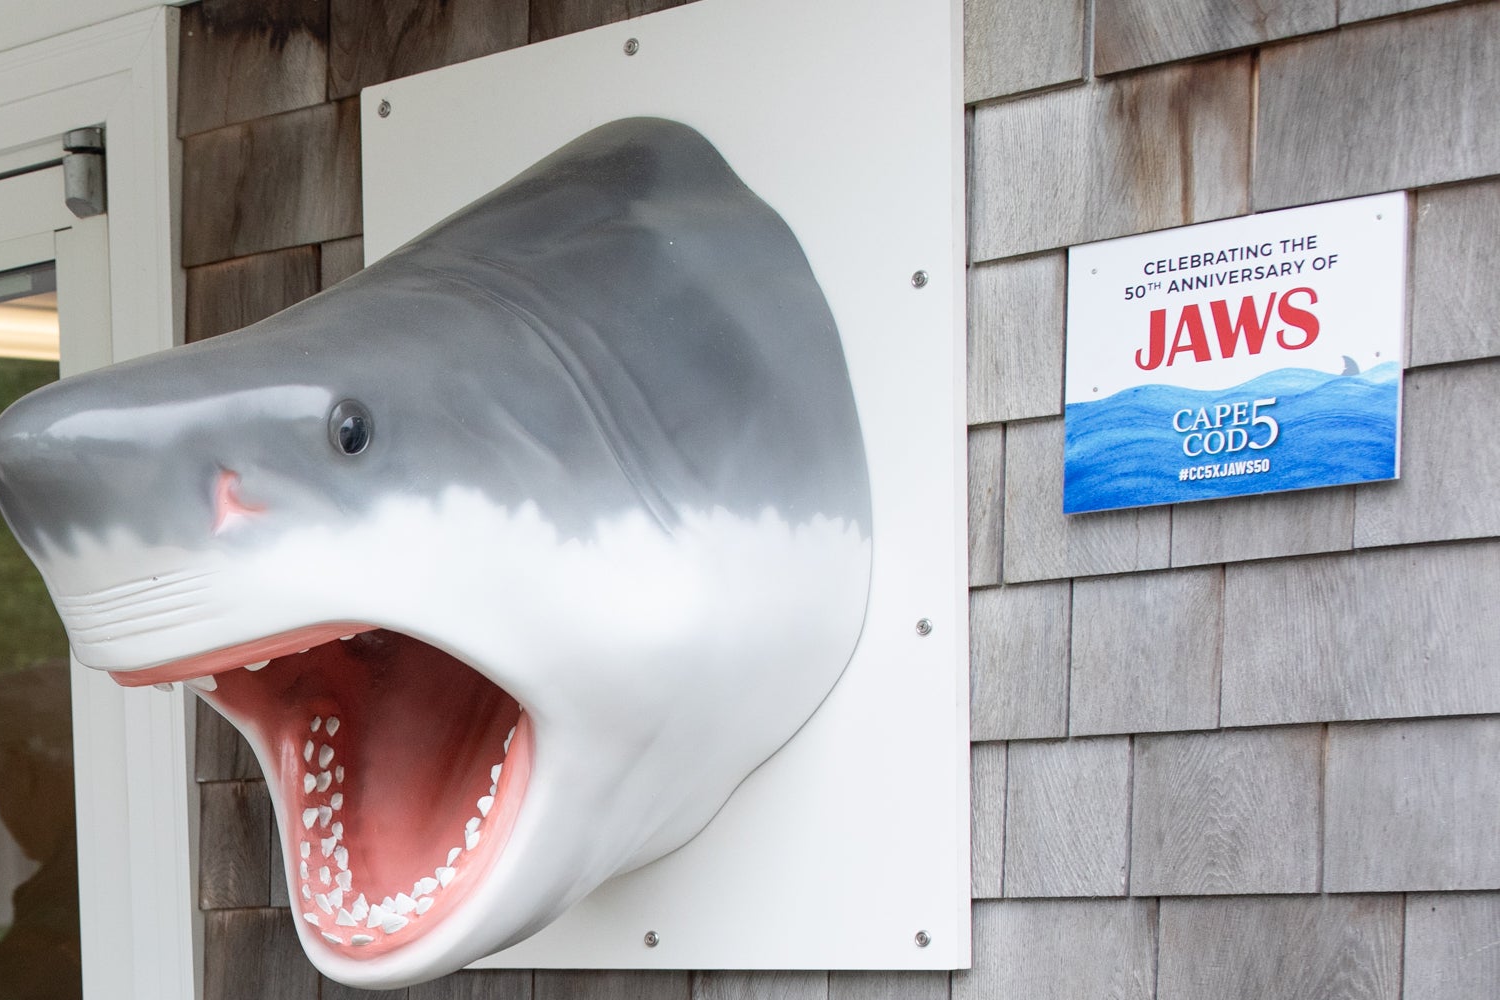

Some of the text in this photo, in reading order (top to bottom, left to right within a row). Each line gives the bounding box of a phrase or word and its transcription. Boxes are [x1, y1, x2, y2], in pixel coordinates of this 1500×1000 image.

[1143, 235, 1318, 275] CELEBRATING THE
[1124, 254, 1338, 300] 50TH ANNIVERSARY OF
[1135, 287, 1320, 370] JAWS
[1172, 397, 1279, 450] CAPE 5
[1182, 428, 1249, 457] COD
[1179, 458, 1270, 481] #CC5XJAWS50
